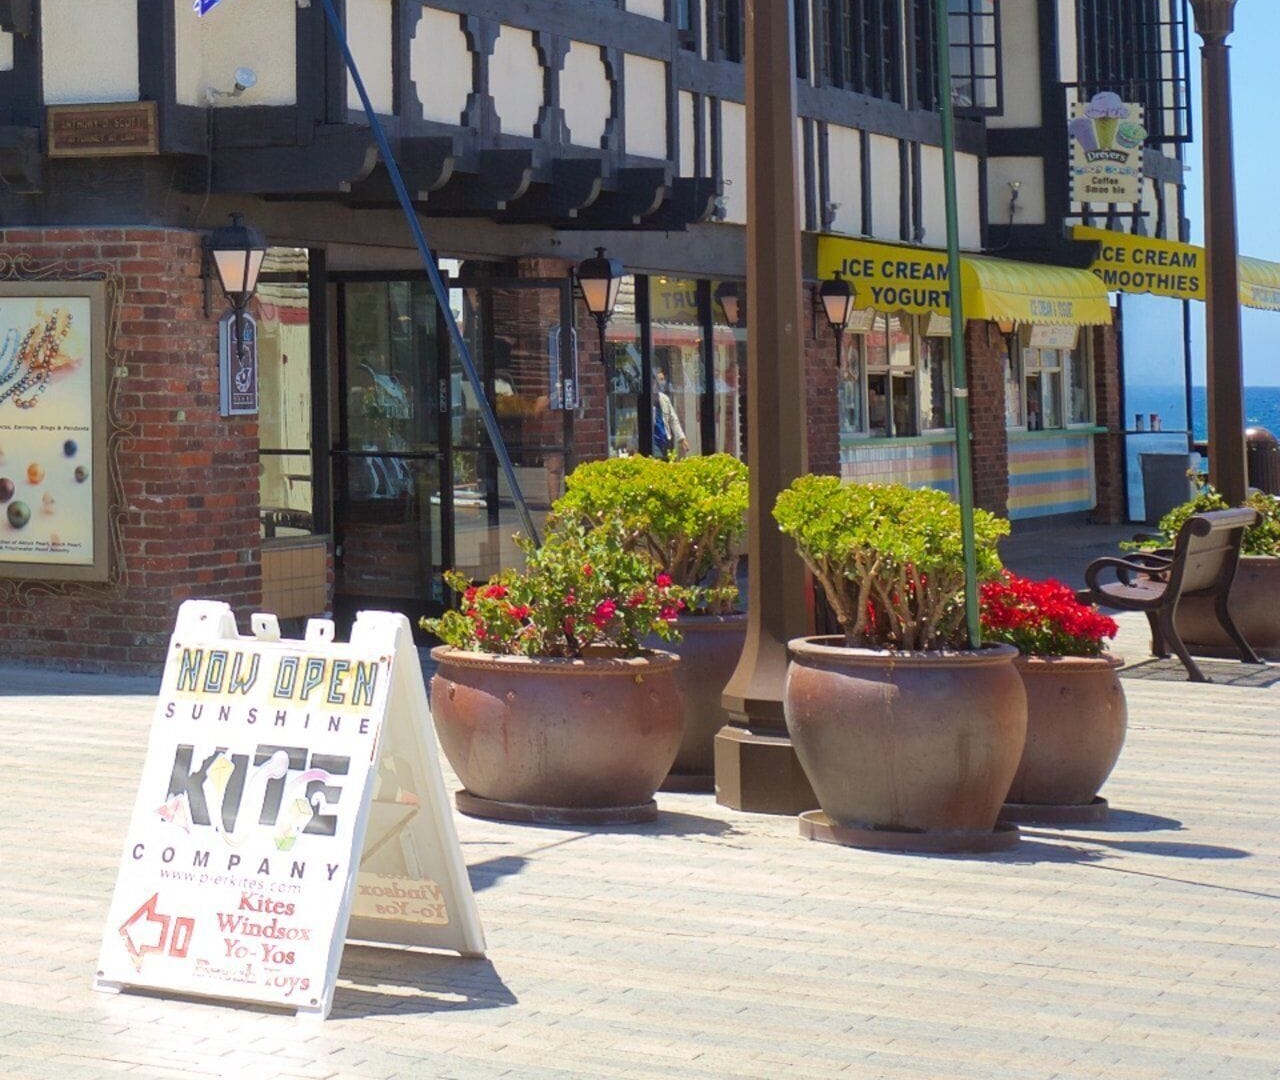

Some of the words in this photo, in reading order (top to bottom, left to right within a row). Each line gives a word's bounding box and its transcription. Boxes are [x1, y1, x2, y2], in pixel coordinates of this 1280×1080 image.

[1092, 176, 1119, 185] Coffee
[841, 258, 874, 277] ICE
[881, 261, 950, 281] CREAM
[1132, 249, 1197, 268] CREAM
[1093, 268, 1200, 292] SMOOTHIES
[870, 286, 951, 308] YOGURT
[177, 648, 260, 695] NOW
[273, 655, 379, 706] OPEN
[165, 702, 371, 735] SUNSHINE
[161, 743, 351, 837] KITE
[131, 842, 339, 882] COMPANY
[238, 891, 296, 916] Kites
[216, 912, 312, 941] Windsox
[224, 937, 296, 965] Yo-Yos
